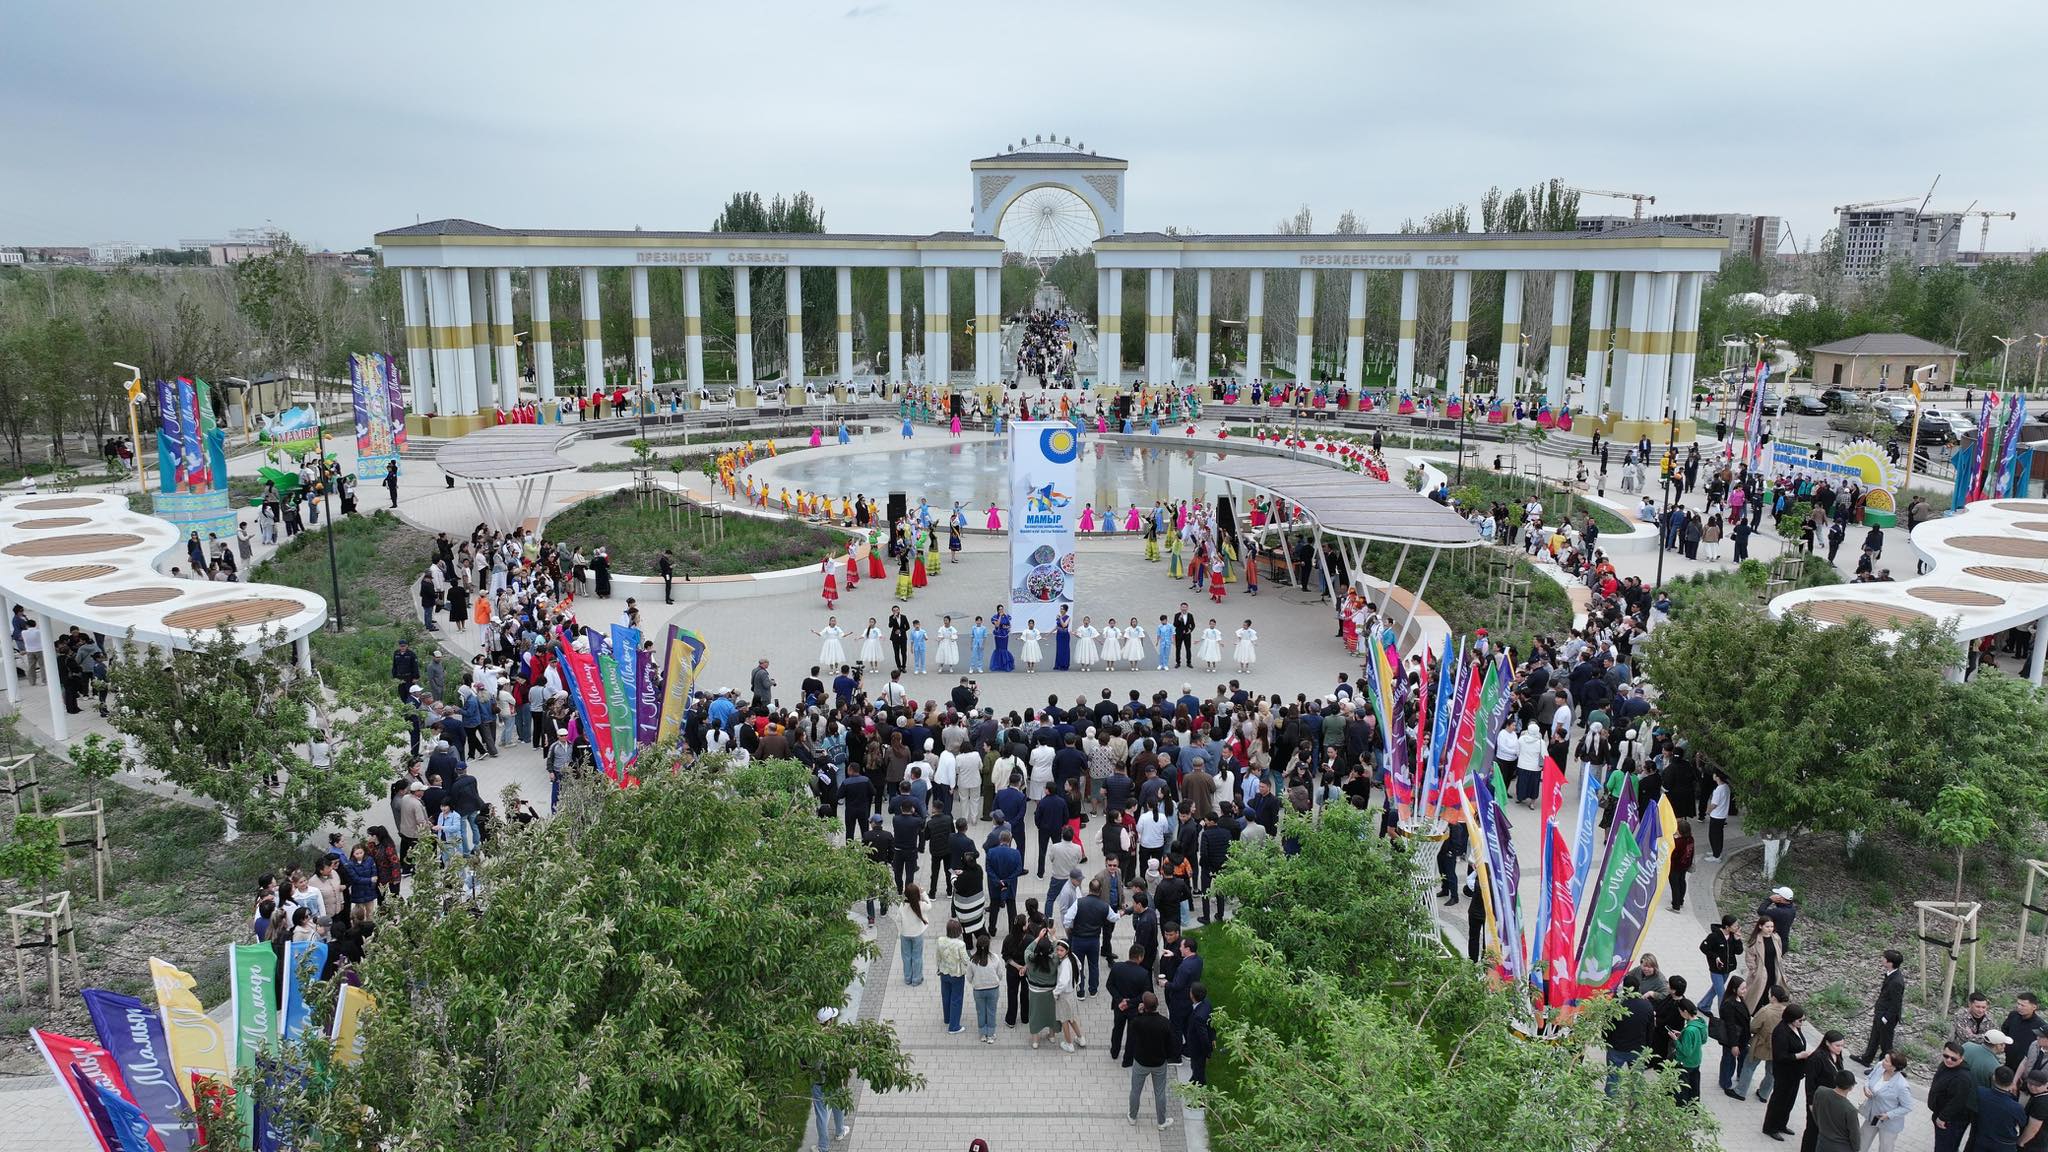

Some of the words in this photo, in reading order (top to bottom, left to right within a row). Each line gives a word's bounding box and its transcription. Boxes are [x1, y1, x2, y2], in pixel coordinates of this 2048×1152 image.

[636, 252, 712, 264] ПРЕЗИДЕНТ
[1300, 253, 1411, 266] ПРЕЗИДЕНТСКИЙ
[1427, 255, 1459, 266] ПАРК
[278, 425, 319, 445] МАМЫР
[1026, 514, 1062, 524] МАМЫР
[127, 1008, 181, 1110] Мамыр
[69, 1046, 122, 1097] амыр
